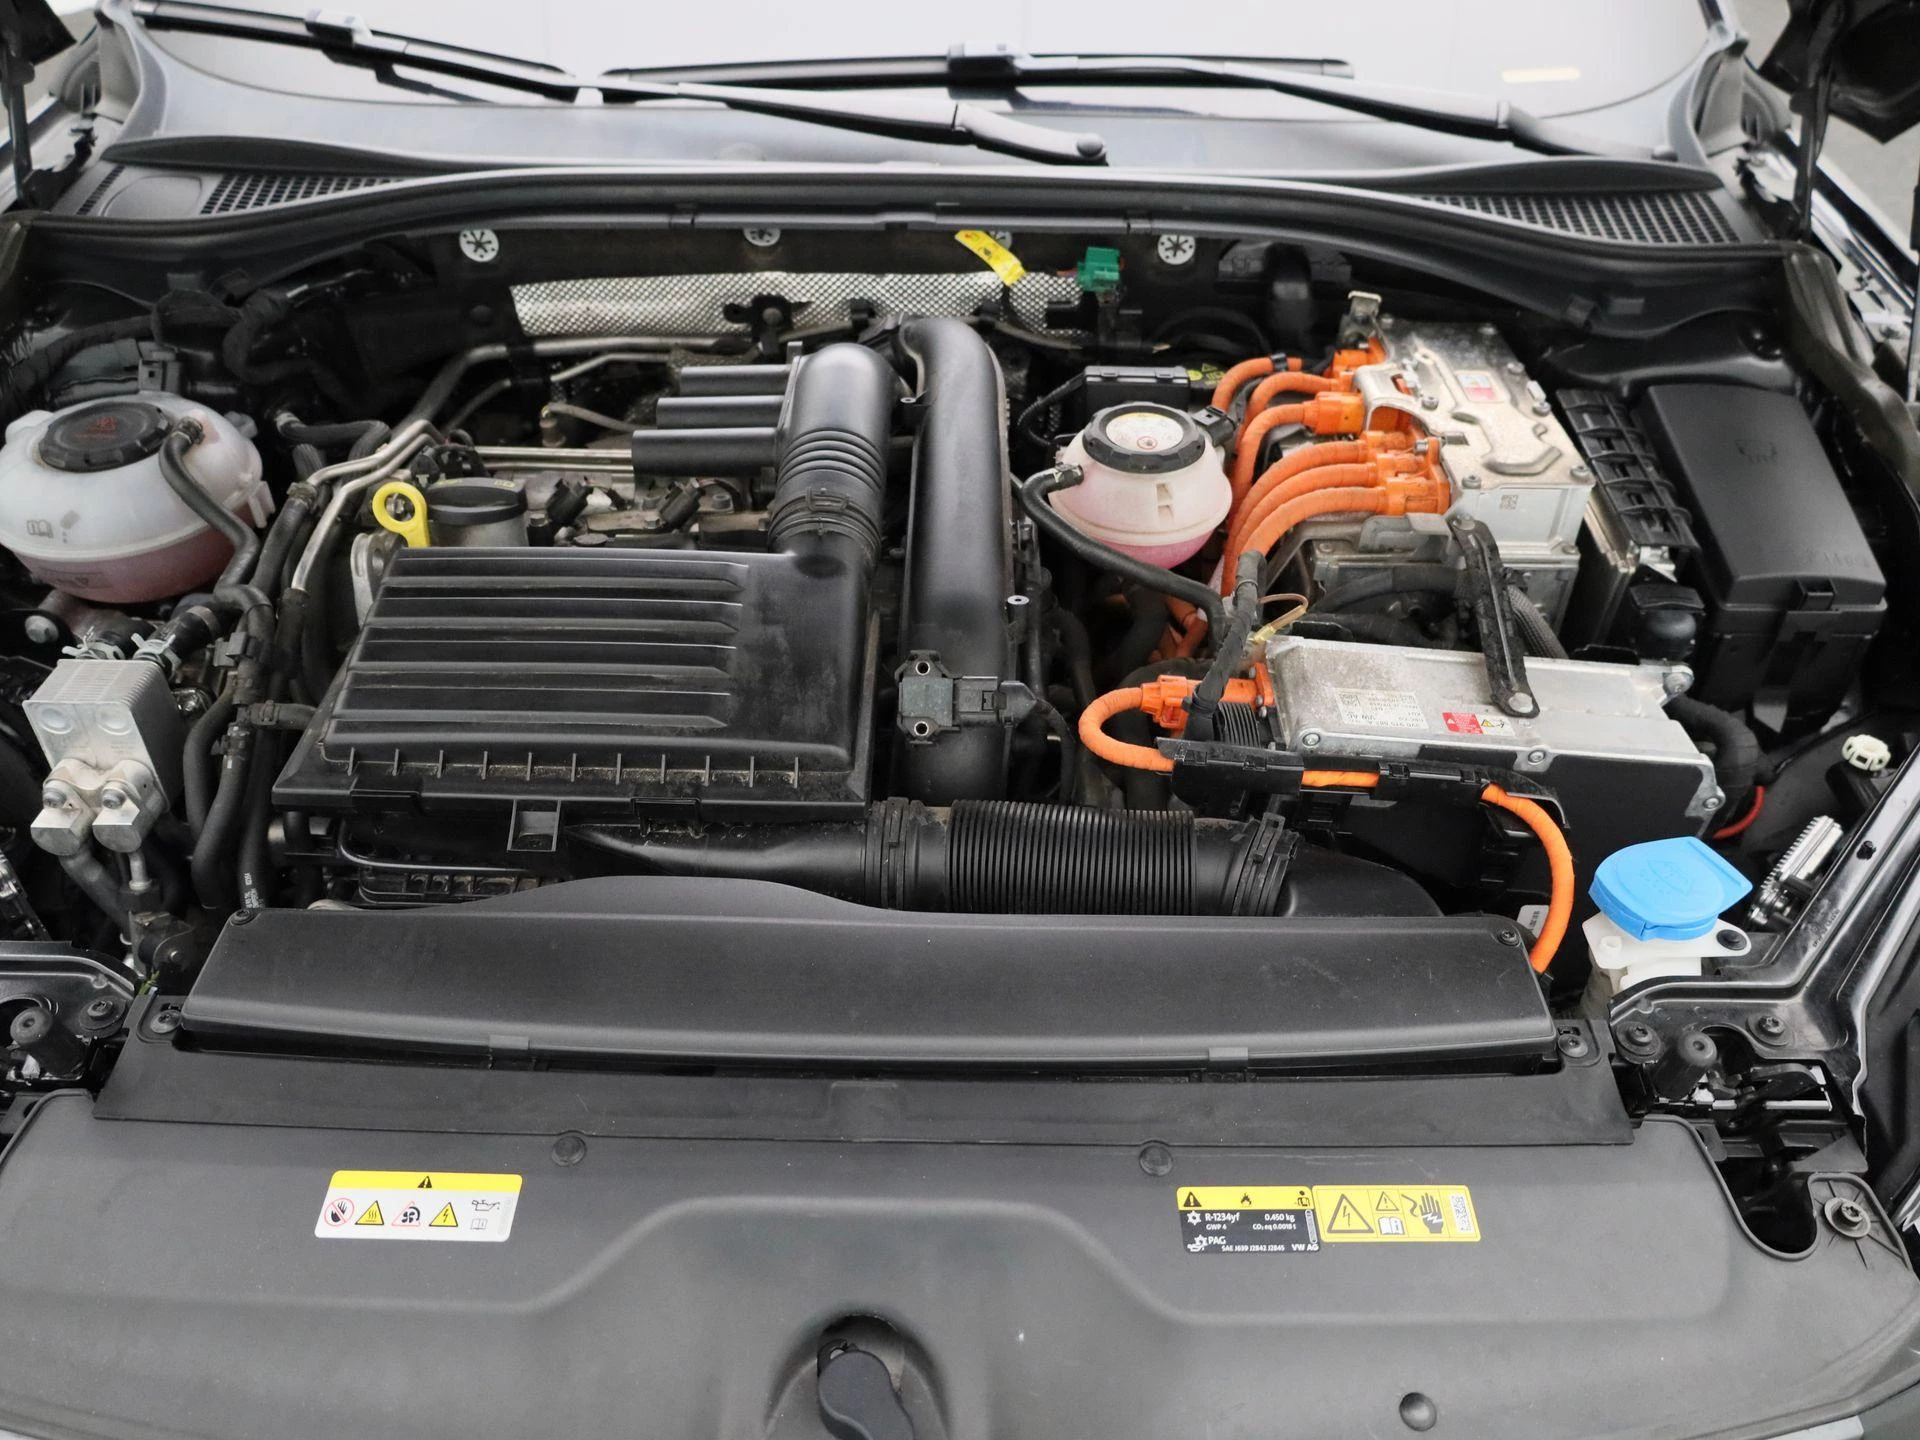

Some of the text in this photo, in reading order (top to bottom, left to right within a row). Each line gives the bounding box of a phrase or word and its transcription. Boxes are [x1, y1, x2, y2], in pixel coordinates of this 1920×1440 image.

[1204, 1212, 1240, 1223] R-1234yf
[1264, 1213, 1295, 1223] 0.450 kg
[1208, 1236, 1226, 1245] PAG
[1306, 1243, 1319, 1251] AG
